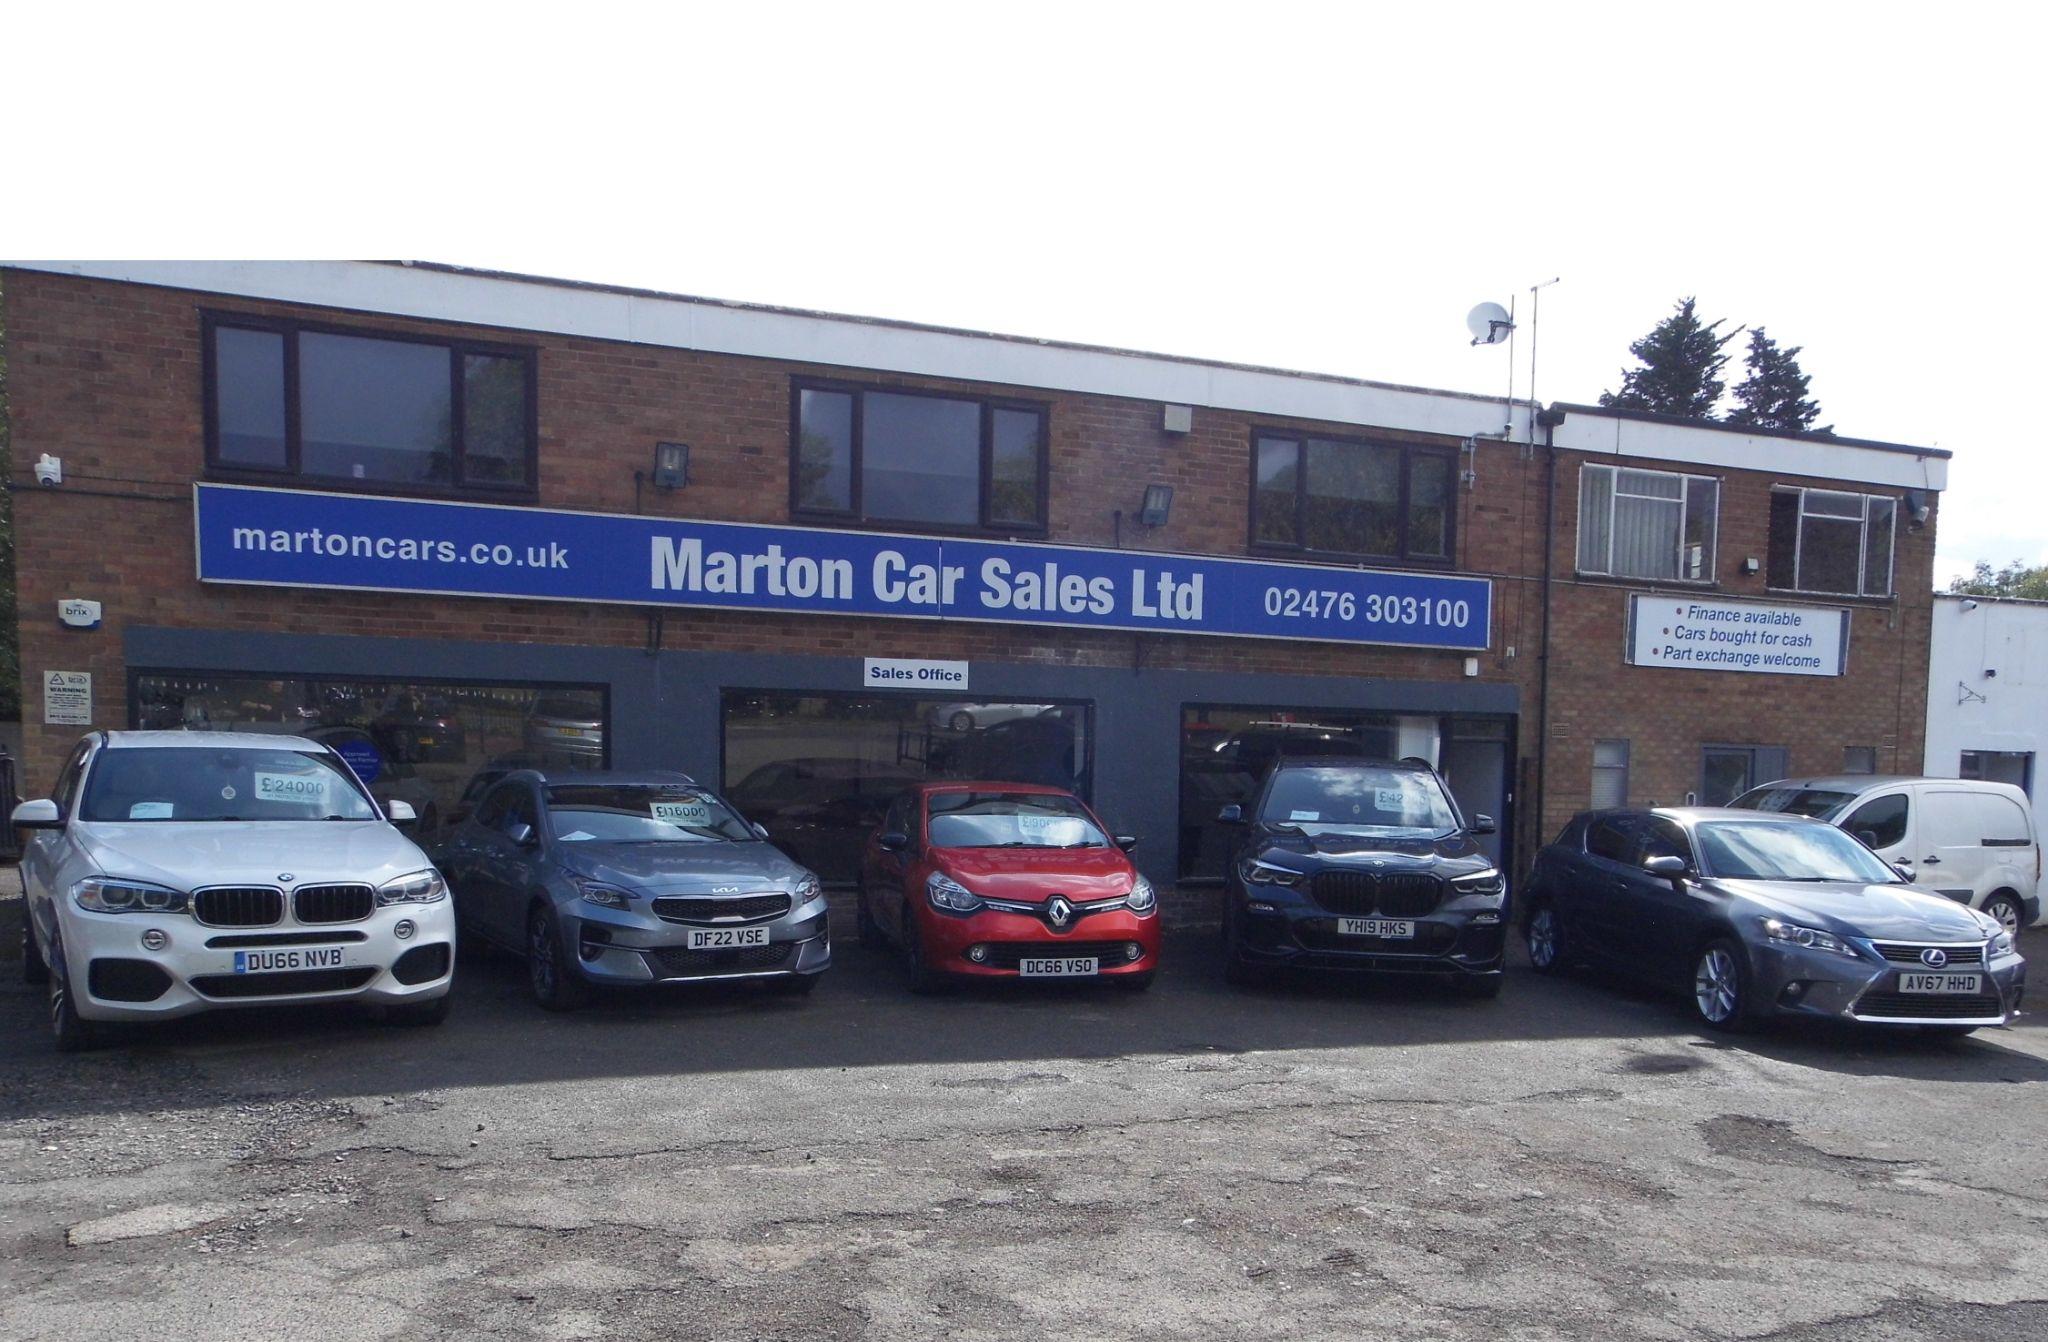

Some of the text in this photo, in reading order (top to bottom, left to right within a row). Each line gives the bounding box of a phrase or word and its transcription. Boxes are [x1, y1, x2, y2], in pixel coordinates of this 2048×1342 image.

[233, 528, 569, 569] martoncars.co.uk
[651, 536, 1204, 621] Marton Car Sales Ltd
[65, 607, 88, 616] brix
[1264, 586, 1469, 628] 02476 303100
[1688, 605, 1802, 627] Finance available
[1674, 625, 1813, 648] Cars bought for cash
[1663, 646, 1821, 668] Part exchange welcome
[871, 666, 962, 681] Sales Office
[261, 777, 325, 795] £24000
[1346, 919, 1407, 935] YH19 HKS
[694, 929, 764, 947] DF22 VSE
[248, 949, 342, 971] DU66 NVB
[1026, 959, 1092, 974] DC66 VSO
[1906, 975, 1976, 991] AV67 HHD
